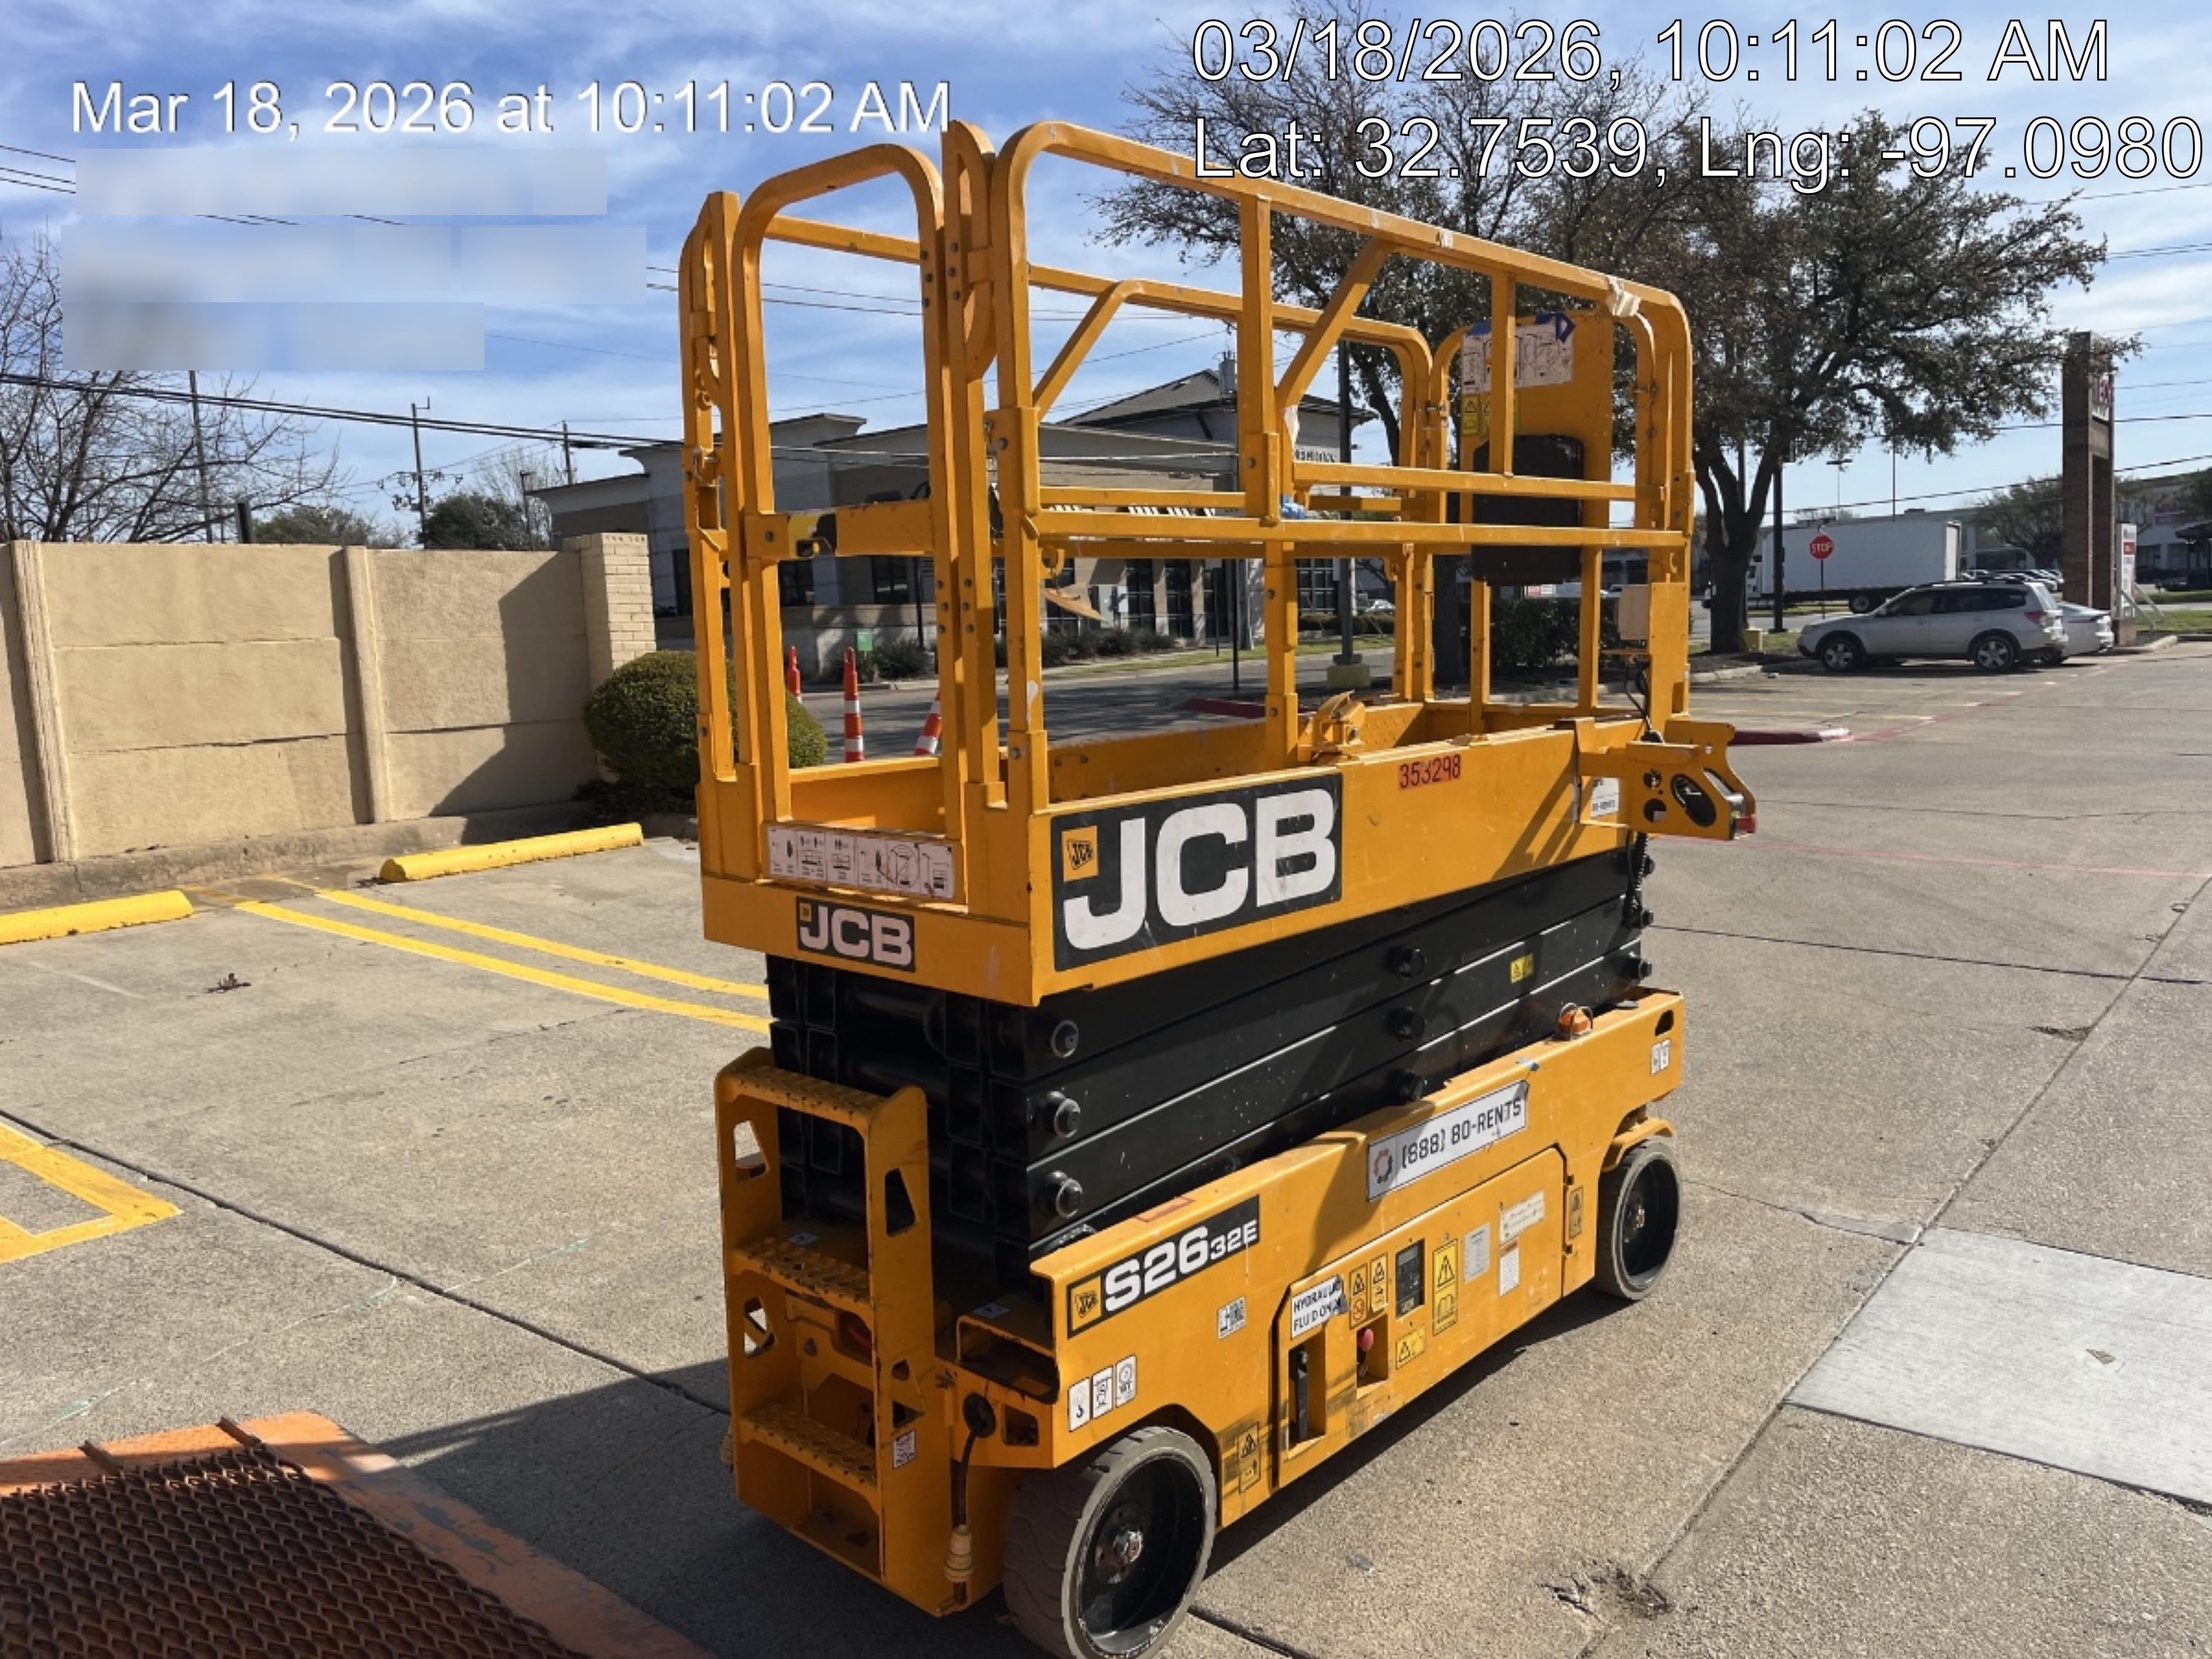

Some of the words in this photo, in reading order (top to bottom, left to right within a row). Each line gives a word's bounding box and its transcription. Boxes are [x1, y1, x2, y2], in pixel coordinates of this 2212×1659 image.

[1811, 541, 1832, 553] STOP
[1400, 754, 1461, 790] 353298
[1064, 788, 1336, 949] JCB
[800, 904, 912, 966] JCB
[1451, 1097, 1522, 1145] 80-RENTS
[1293, 1310, 1319, 1332] FLUD
